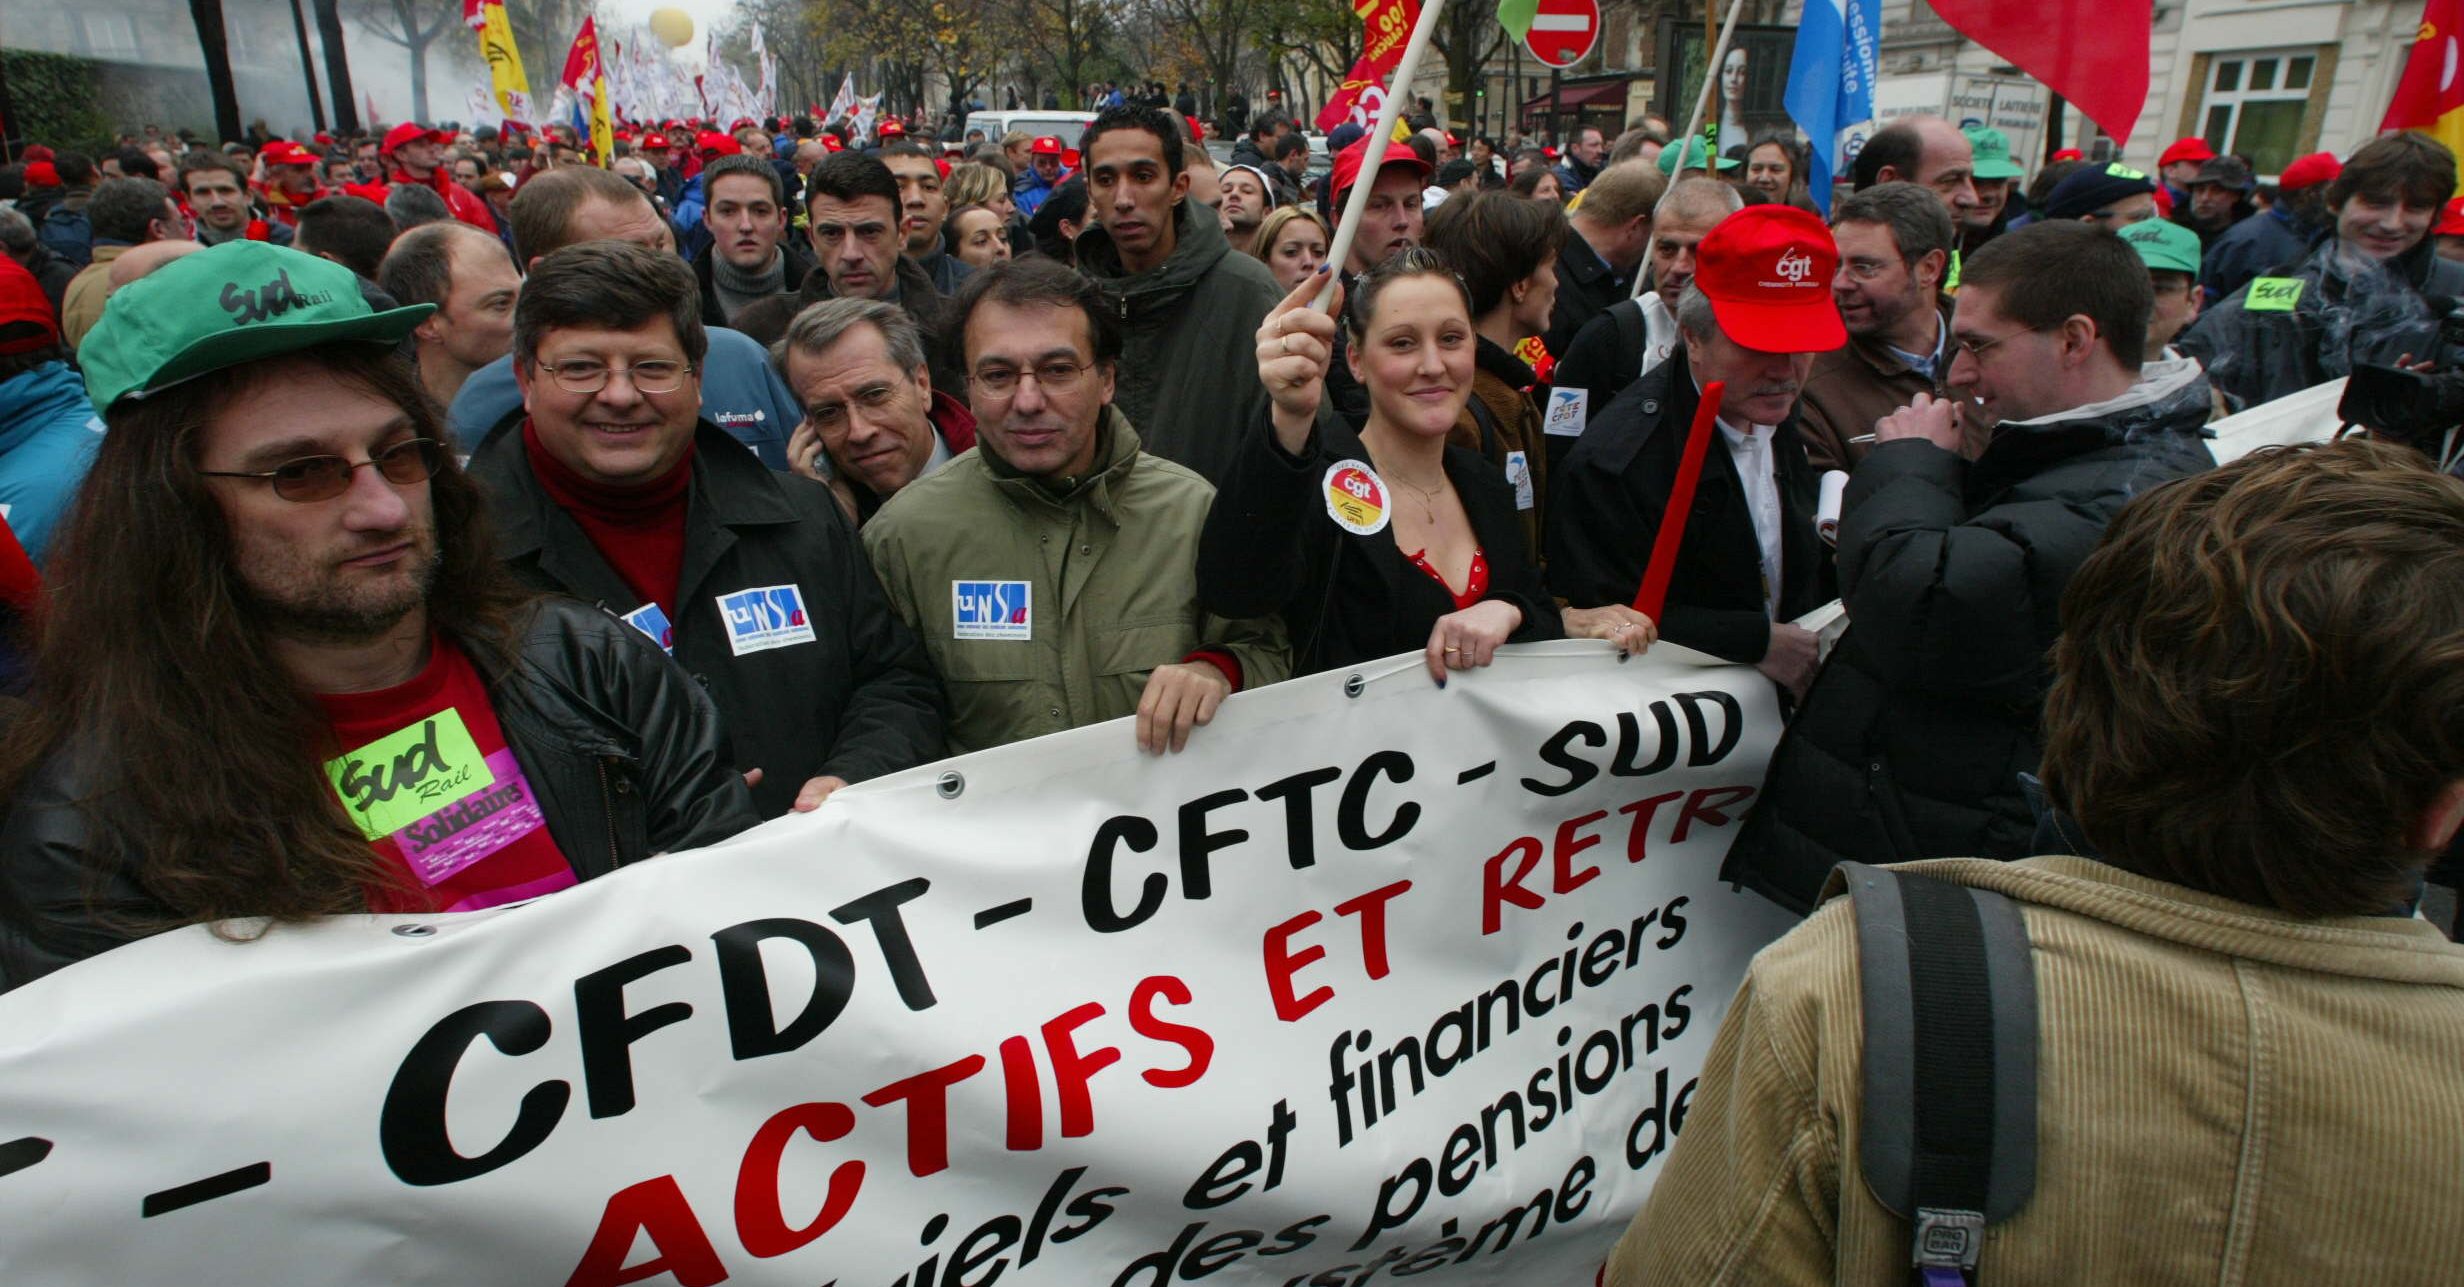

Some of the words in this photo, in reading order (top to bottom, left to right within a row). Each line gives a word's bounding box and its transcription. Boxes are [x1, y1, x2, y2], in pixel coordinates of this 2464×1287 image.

[219, 267, 304, 325] Sud
[714, 411, 754, 423] lafuma
[1343, 475, 1371, 499] cgt
[340, 720, 451, 812] Sud
[416, 764, 471, 804] Rail
[404, 782, 524, 853] Solidaires
[380, 878, 936, 1186] CFDT
[1082, 751, 1421, 933] CFTC
[1520, 690, 1743, 797] SUD
[563, 976, 1214, 1287] ACTIFS
[1264, 880, 1411, 1021] ET
[1483, 786, 1748, 935] RETR
[1182, 1099, 1297, 1210] et
[1330, 896, 1691, 1148] financiers
[1108, 1221, 1332, 1287] des
[1347, 983, 1694, 1252] pensions
